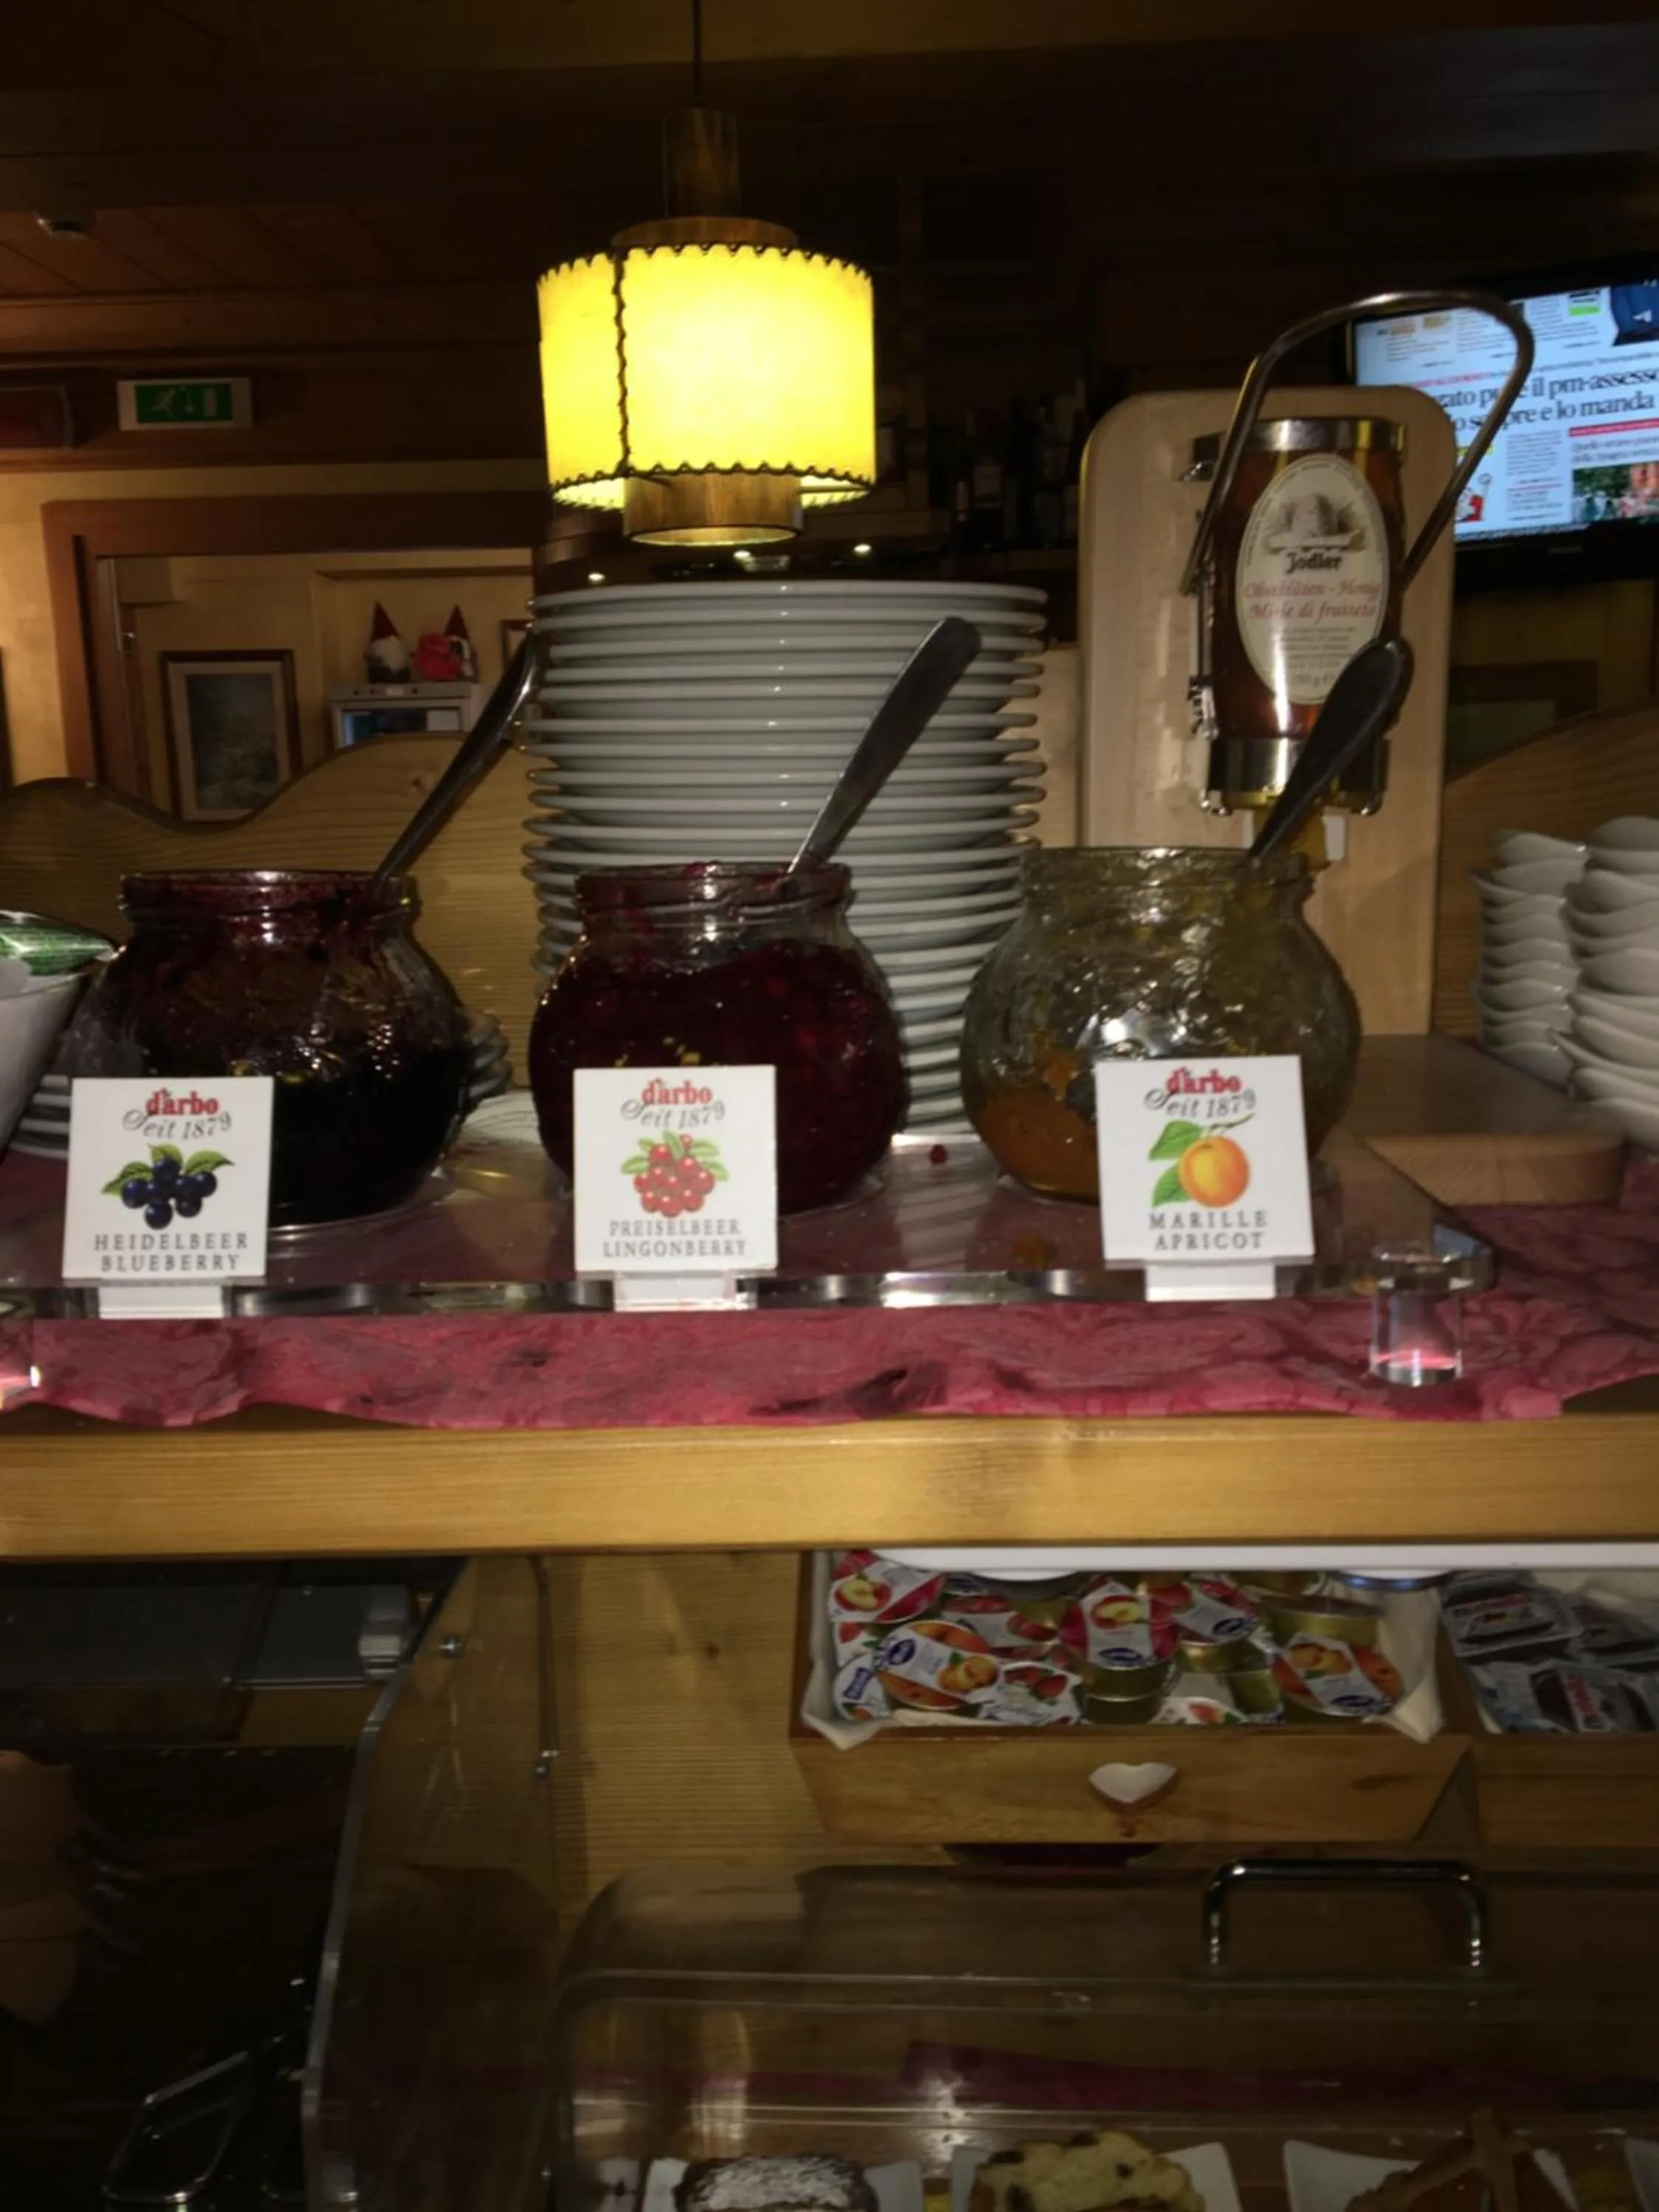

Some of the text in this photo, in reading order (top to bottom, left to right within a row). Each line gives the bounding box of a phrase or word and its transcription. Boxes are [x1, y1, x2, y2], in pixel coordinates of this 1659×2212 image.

[1540, 406, 1553, 421] e
[1556, 400, 1576, 420] lo
[1580, 390, 1655, 417] manda
[1144, 1088, 1258, 1119] Seit 1879
[122, 1109, 232, 1140] Seit 1879
[620, 1099, 726, 1130] Seit 1879
[609, 1218, 741, 1238] PREISELBEER
[1149, 1211, 1268, 1230] MARILLE
[94, 1233, 248, 1251] HEIDELBEER
[602, 1239, 747, 1259] LINGONBERRY
[1155, 1231, 1264, 1251] APRICOT
[101, 1253, 240, 1273] BLUEBERRY
